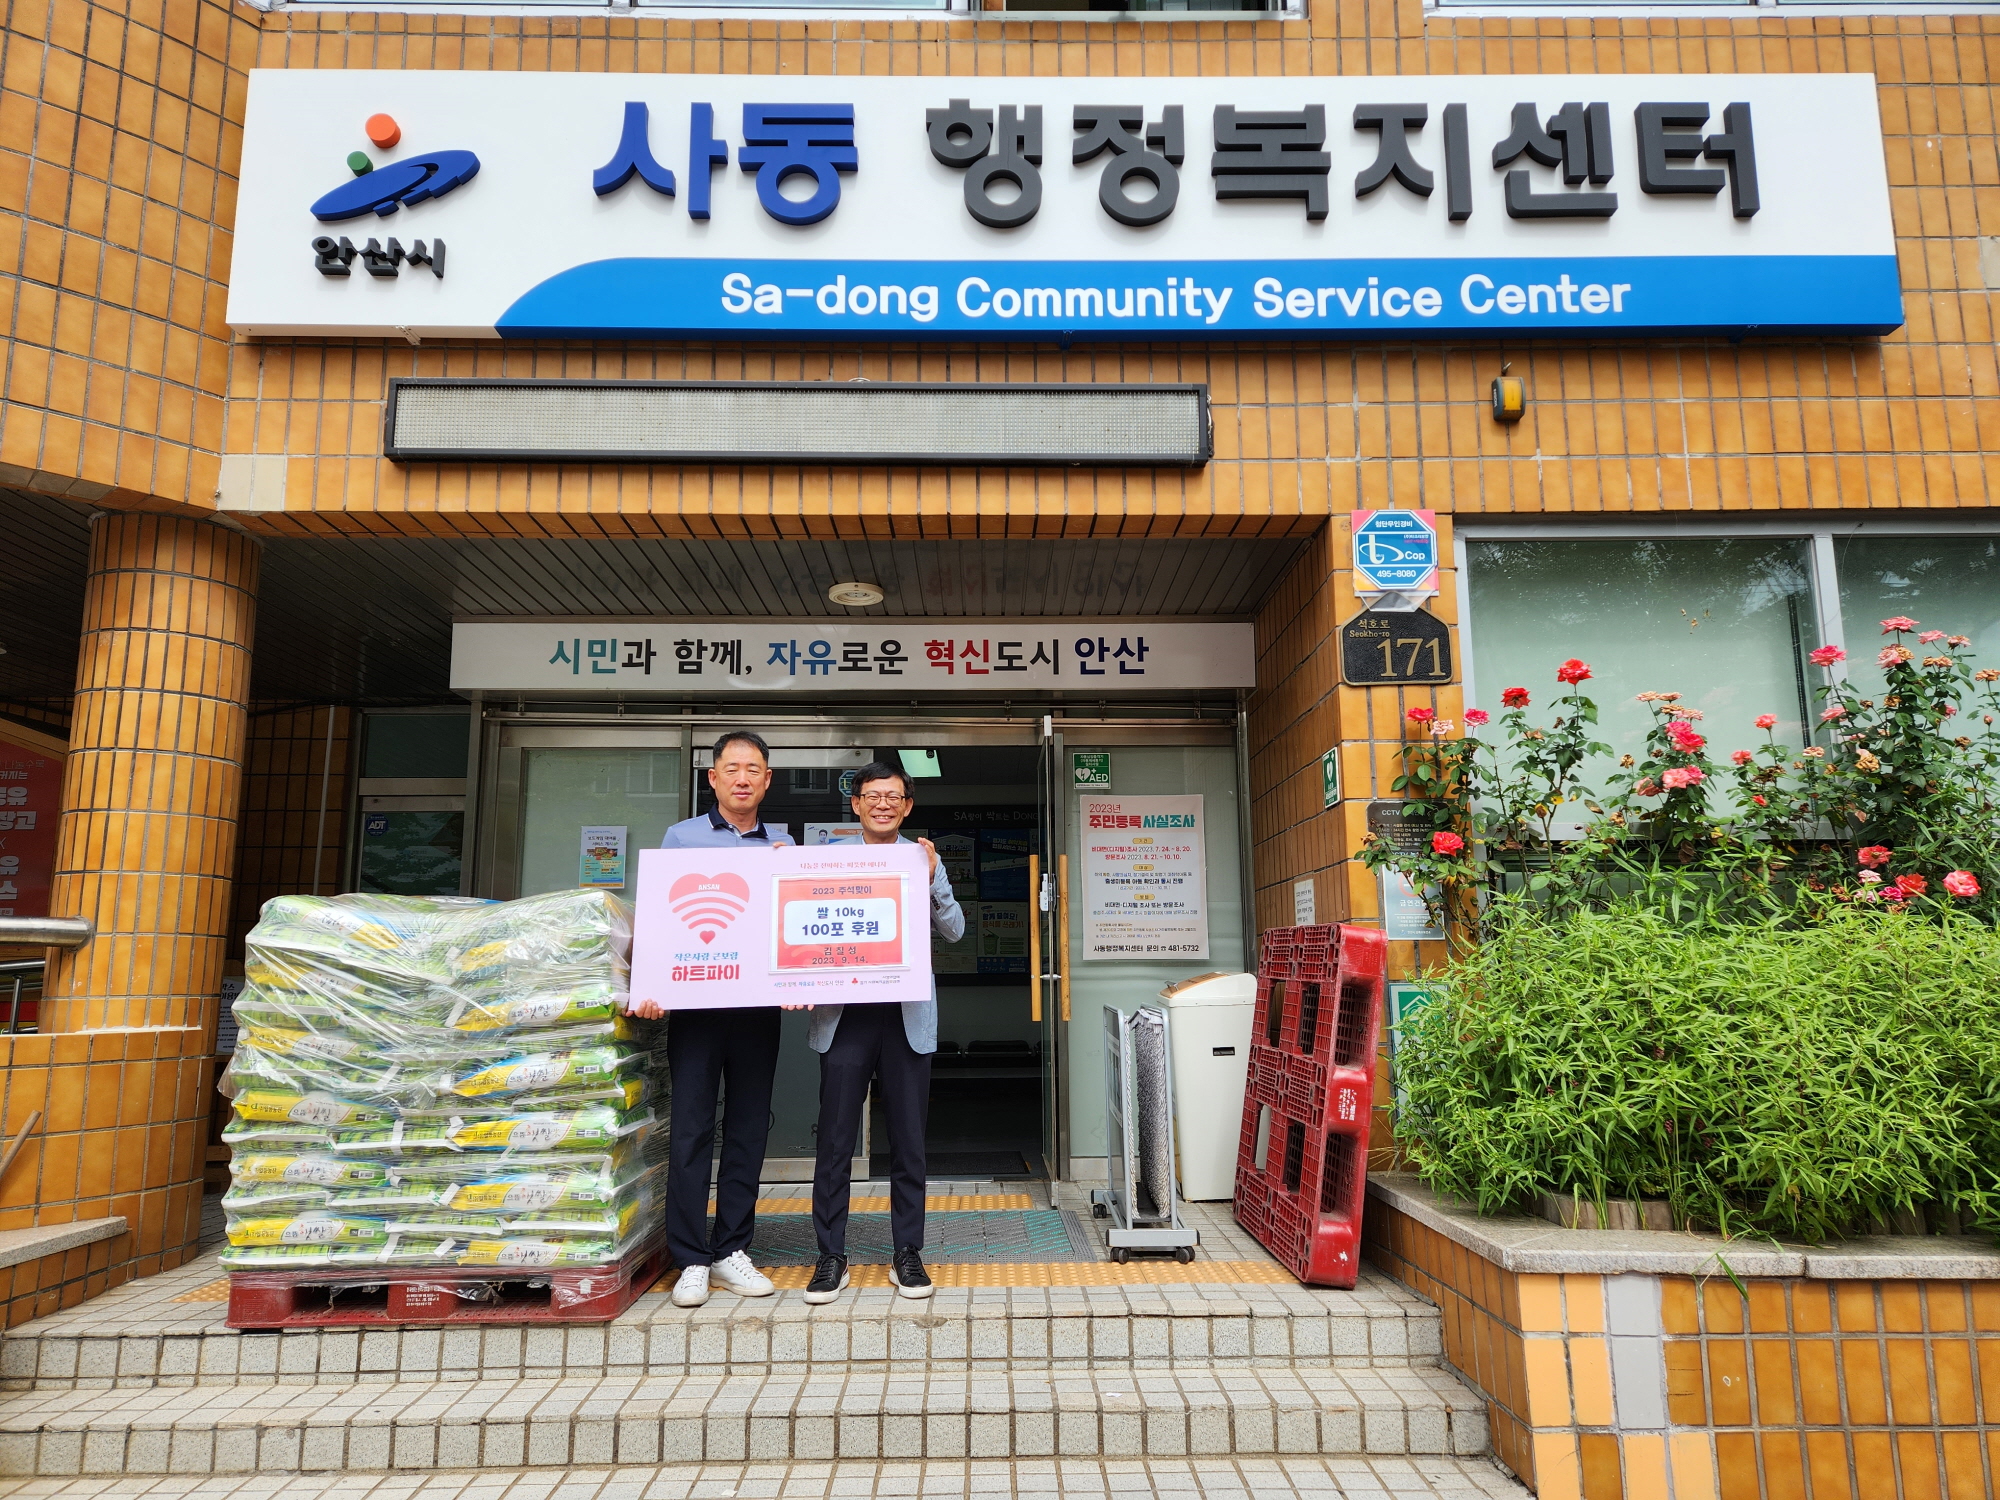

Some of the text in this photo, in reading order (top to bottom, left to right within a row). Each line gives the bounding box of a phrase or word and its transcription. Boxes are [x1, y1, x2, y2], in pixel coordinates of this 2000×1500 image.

[592, 97, 1761, 228] 사동 행정복지센터
[311, 236, 446, 278] 안산시
[721, 272, 1632, 324] Sa-dong Community Service Center
[1405, 550, 1425, 562] Cop
[1358, 619, 1390, 629] 석호로
[548, 638, 1150, 677] 시민과 함께, 자유로운 혁신도시 안산
[1377, 638, 1446, 676] 171
[1089, 774, 1108, 782] AED
[0, 786, 28, 806] 유
[1089, 804, 1121, 814] 2023년
[368, 820, 386, 830] ADT
[1089, 814, 1195, 828] 주민등록 사실조사
[698, 883, 720, 891] ANSAN
[817, 907, 864, 919] 쌀 10kg
[802, 921, 879, 936] 100포 후원
[672, 964, 740, 981] 하트파이
